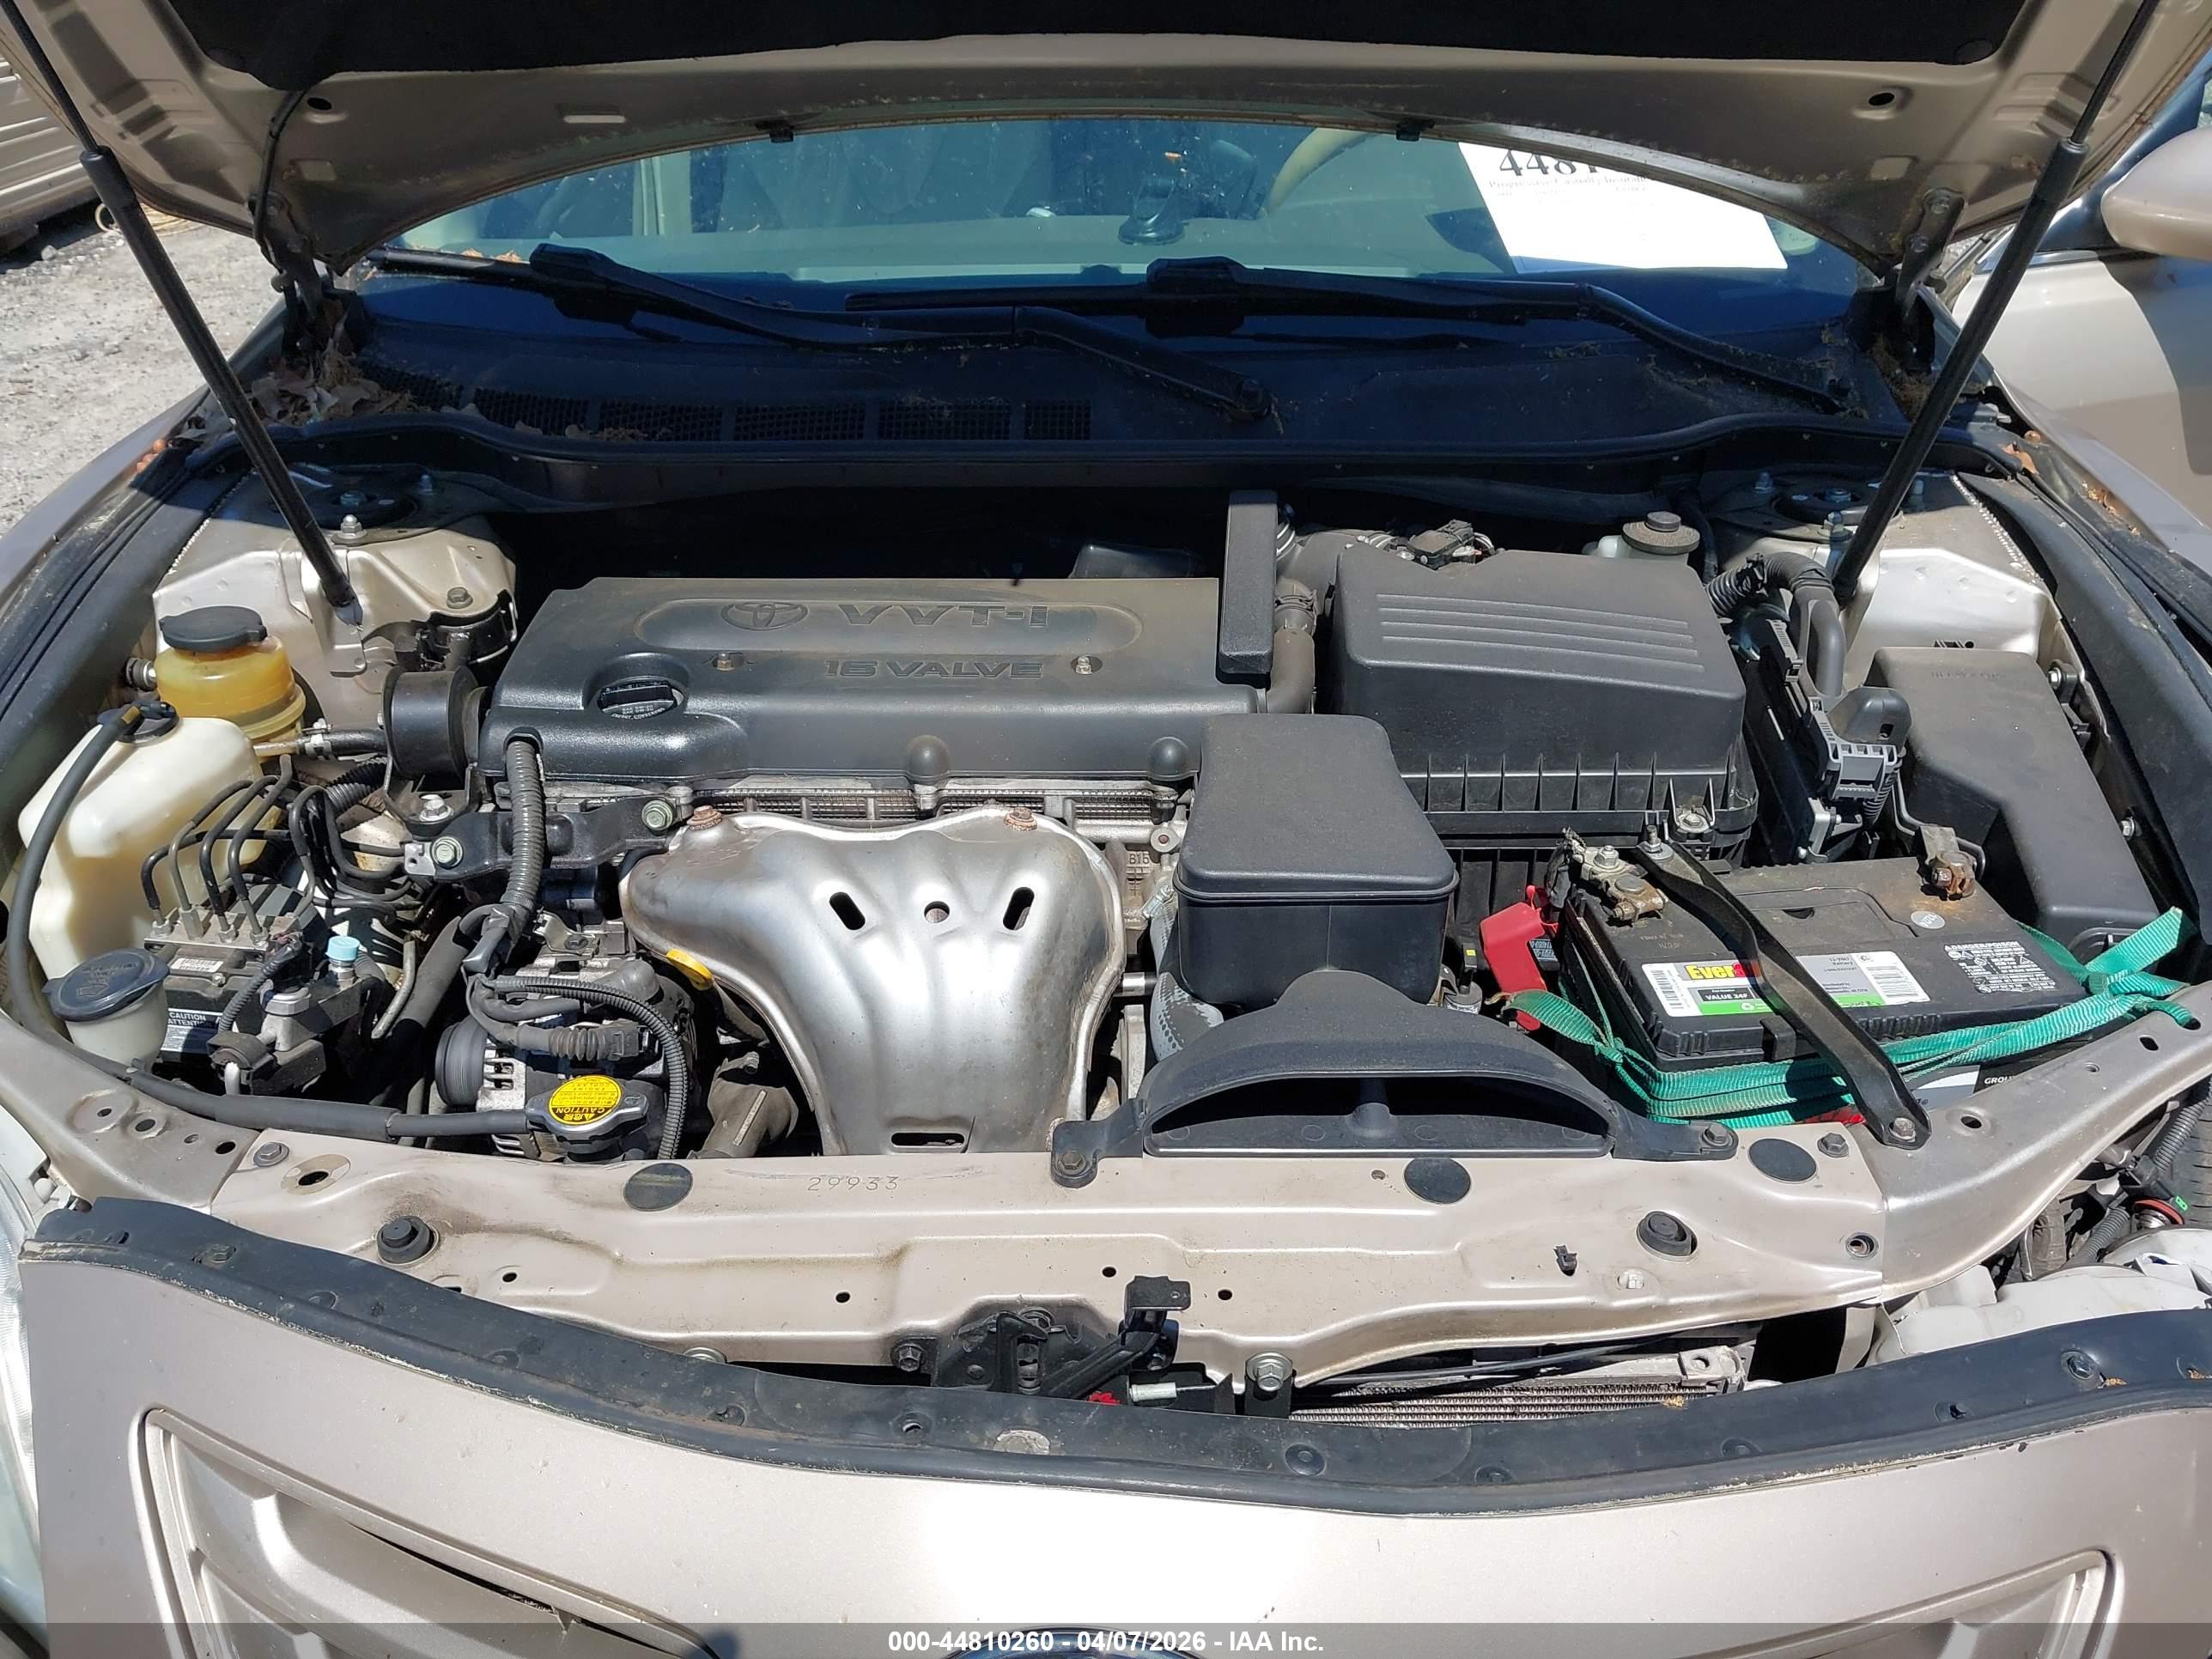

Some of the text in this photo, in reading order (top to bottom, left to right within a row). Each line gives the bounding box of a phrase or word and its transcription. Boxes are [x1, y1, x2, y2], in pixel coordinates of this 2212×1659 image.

[825, 660, 1043, 679] 16 VALVE
[168, 1012, 206, 1022] CAUTION
[807, 1176, 899, 1191] 29933
